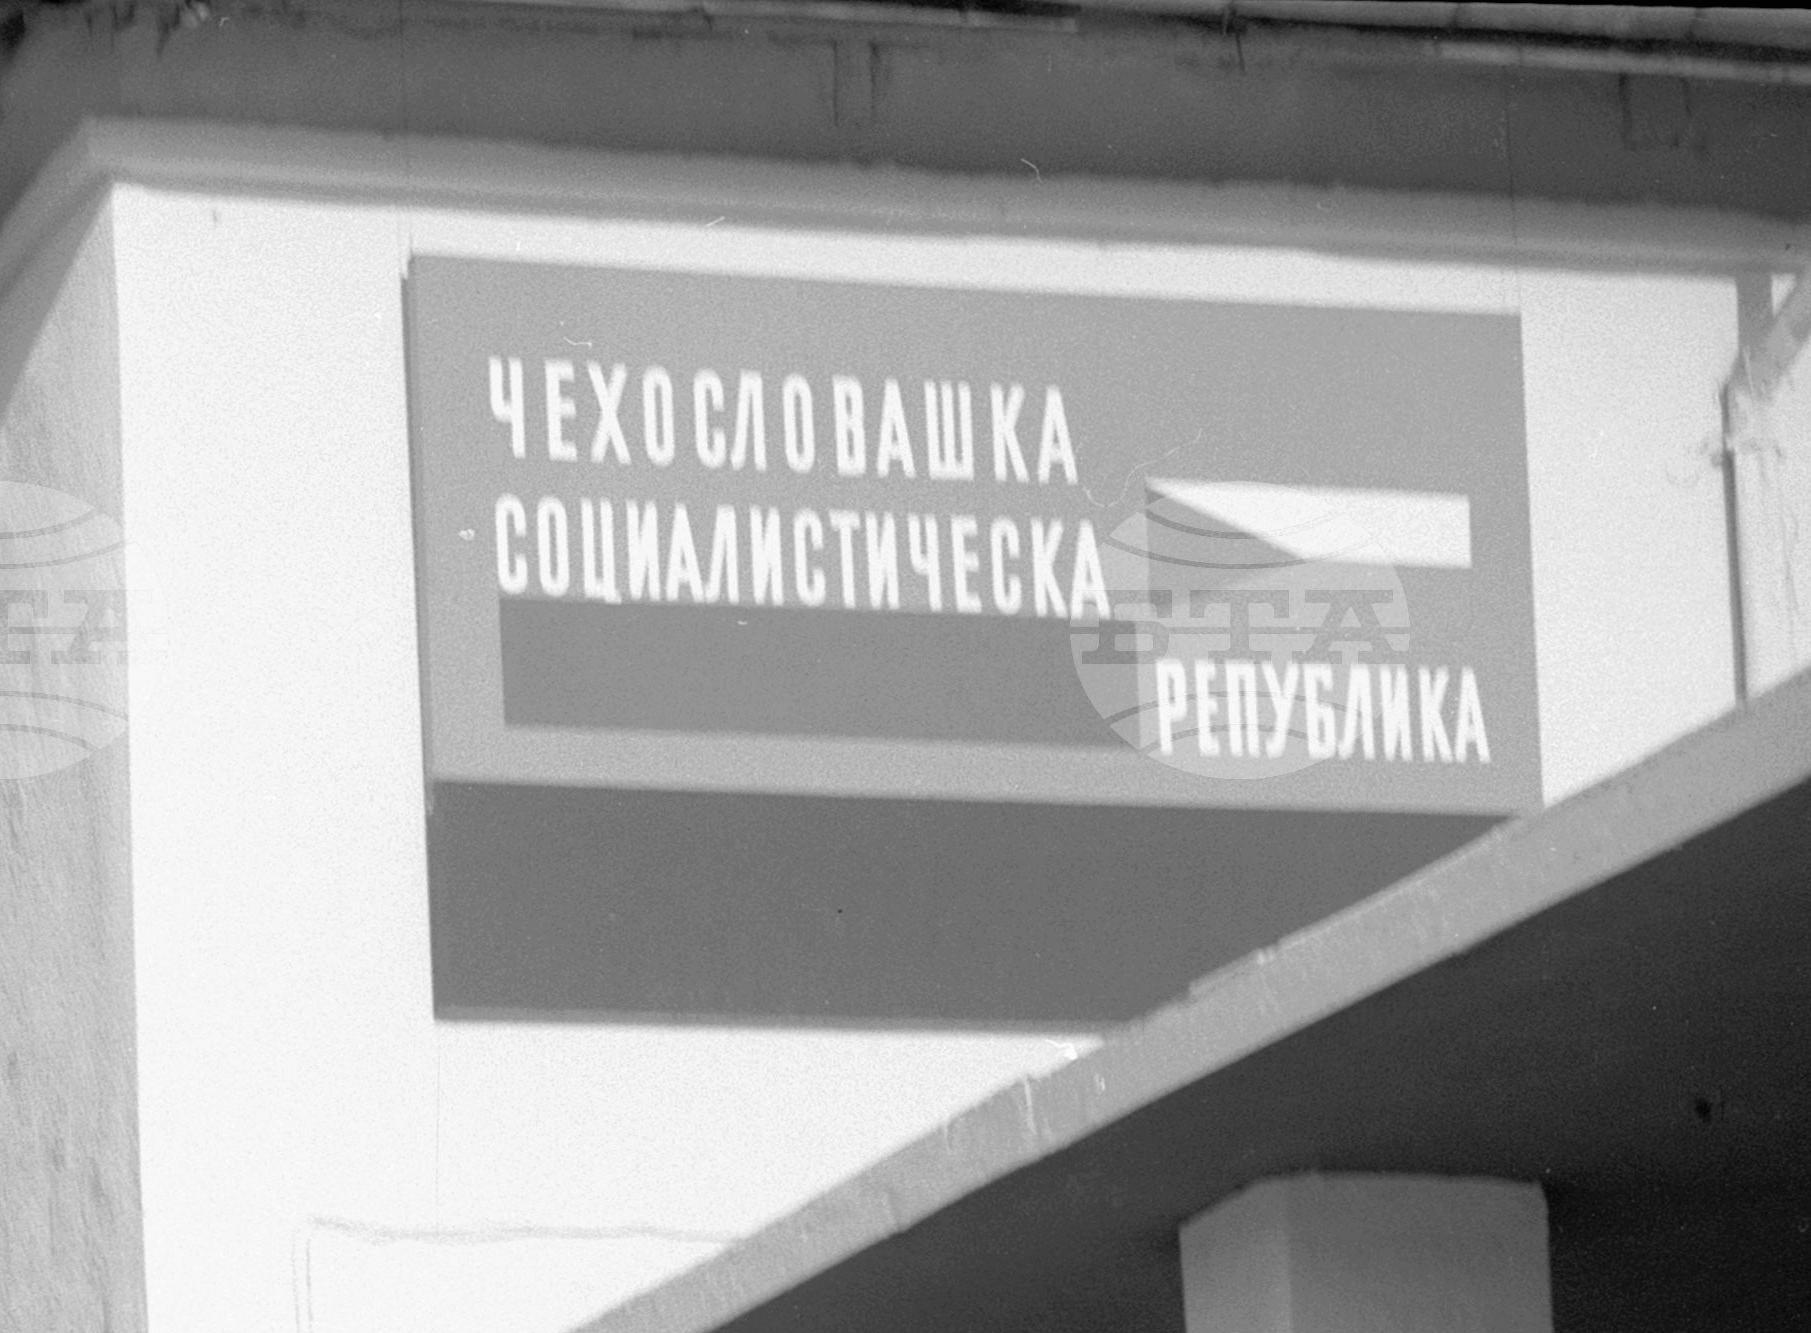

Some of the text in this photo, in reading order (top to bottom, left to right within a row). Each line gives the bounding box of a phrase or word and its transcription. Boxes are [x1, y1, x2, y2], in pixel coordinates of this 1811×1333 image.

[488, 356, 1078, 486] ЧЕХОСЛОВАШКА
[494, 492, 1111, 619] СОЦИАЛИСТИЧЕСКА
[1155, 658, 1491, 765] РЕПУБЛИКА
